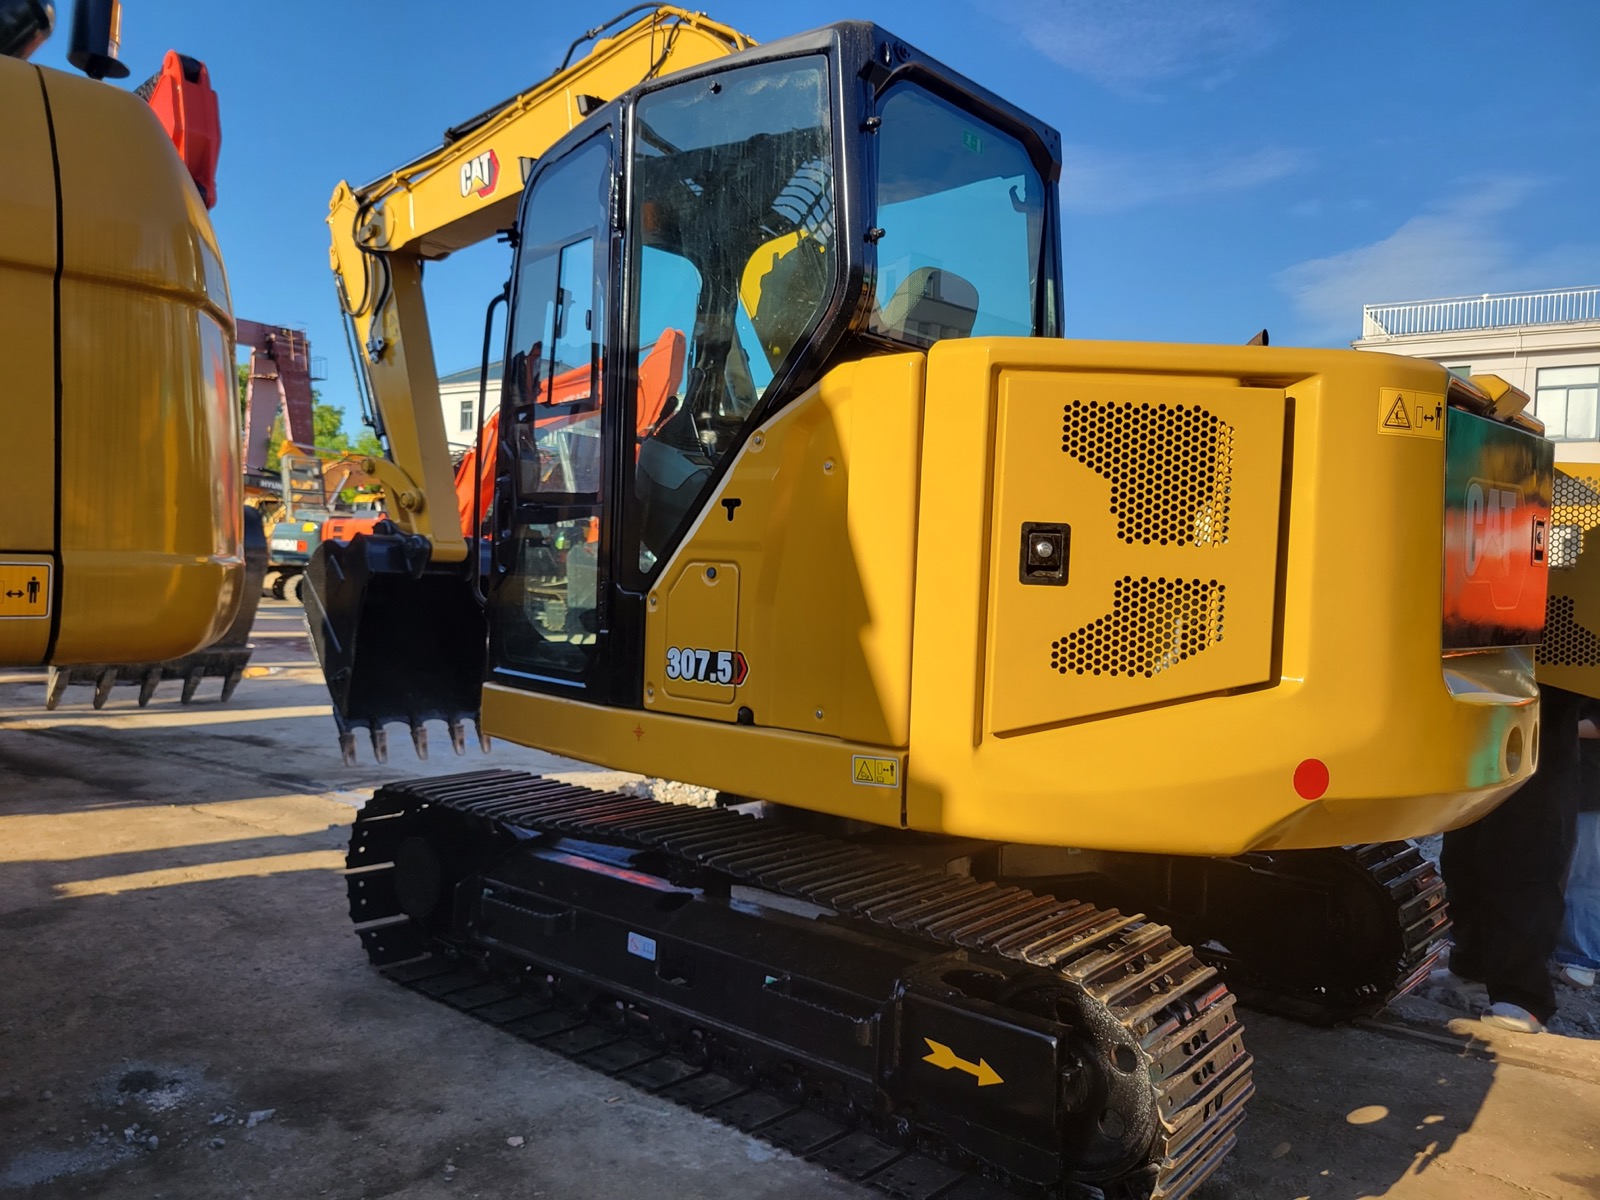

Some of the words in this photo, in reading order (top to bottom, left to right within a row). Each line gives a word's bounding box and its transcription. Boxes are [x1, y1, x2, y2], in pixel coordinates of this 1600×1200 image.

[460, 150, 491, 197] CAT
[1465, 483, 1517, 577] CAT
[666, 646, 733, 684] 307.5
